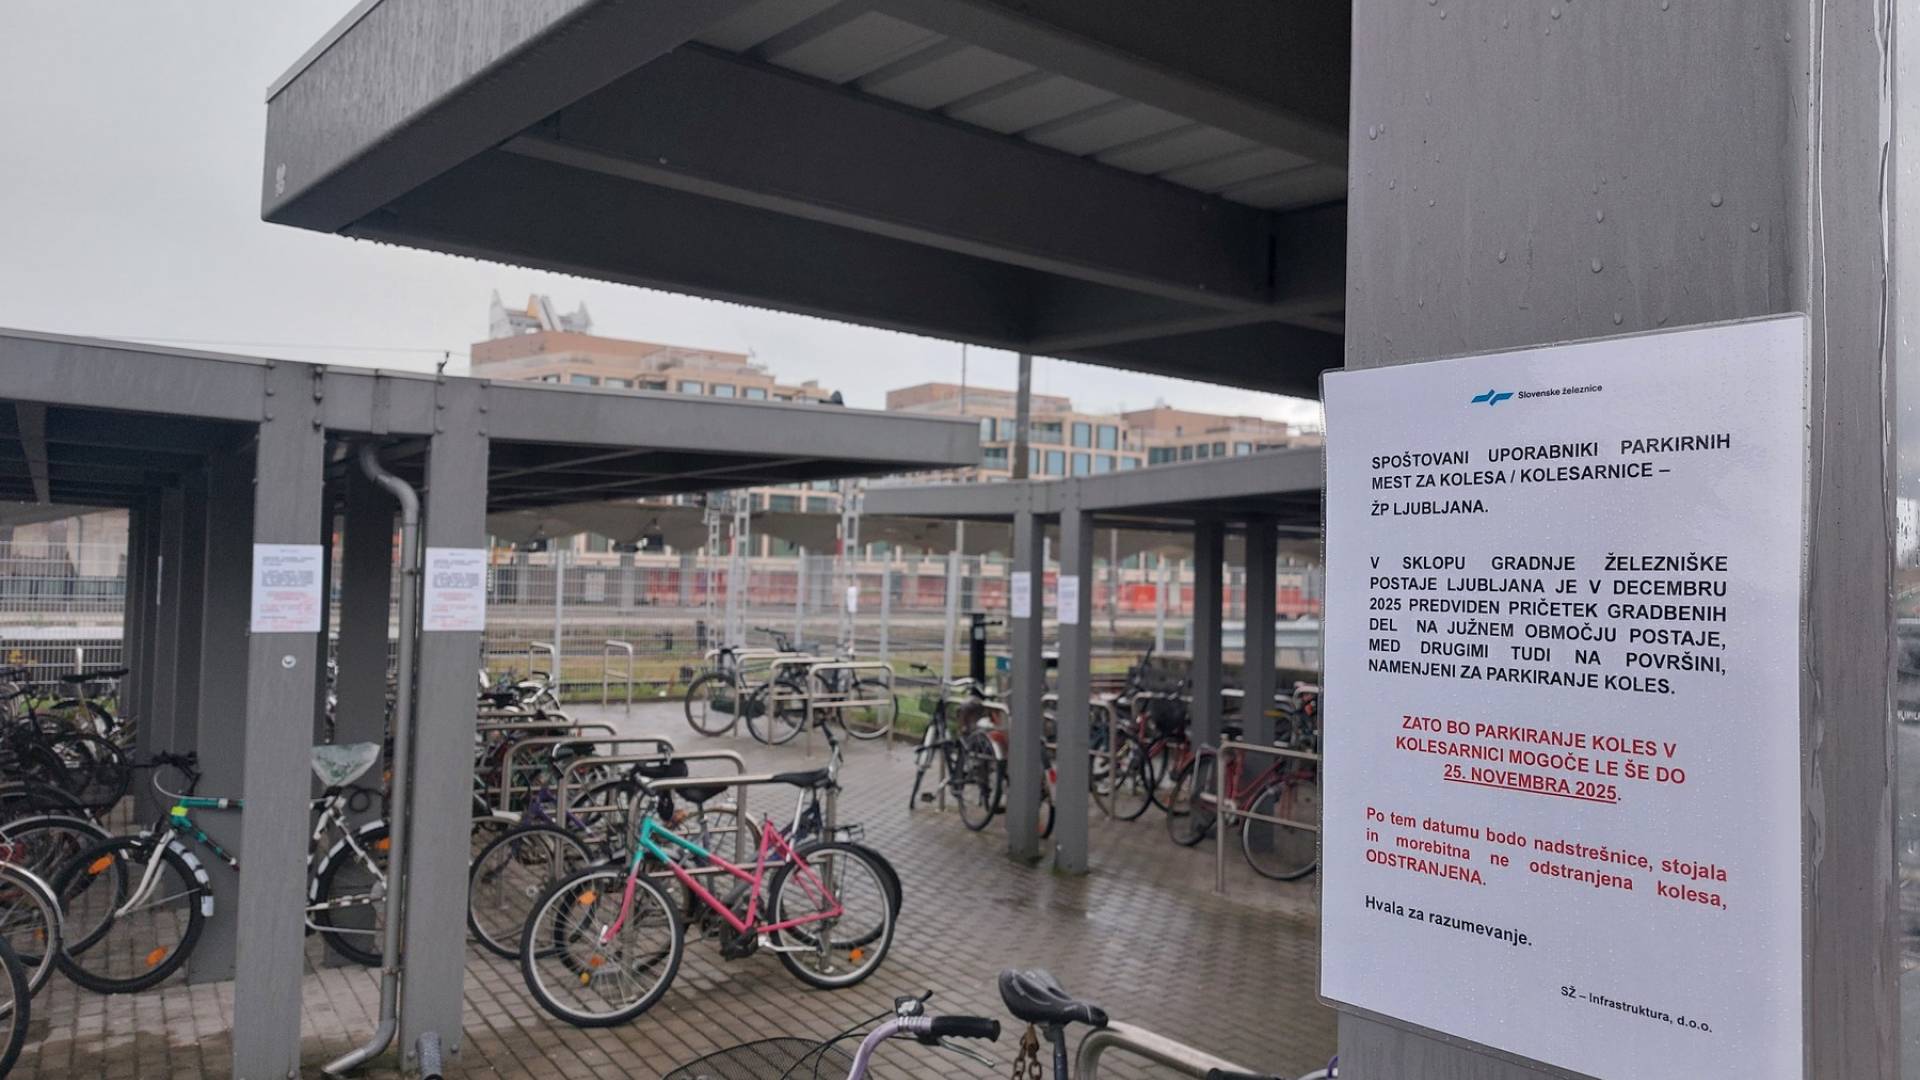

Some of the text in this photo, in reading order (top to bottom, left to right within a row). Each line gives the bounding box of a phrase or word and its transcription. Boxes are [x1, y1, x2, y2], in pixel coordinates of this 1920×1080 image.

[1517, 383, 1603, 400] Slovenske železnice
[1371, 432, 1731, 470] SPOŠTOVANI UPORABNIKI PARKIRNIH
[1371, 474, 1413, 491] MEST
[1415, 473, 1437, 488] ZA
[1439, 469, 1507, 487] KOLESA
[1520, 461, 1654, 484] KOLESARNICE
[1370, 499, 1489, 517] ŽP LJUBLJANA.
[1369, 551, 1728, 572] V SKLOPU GRADNJE ŽELEZNIŠKE
[1369, 576, 1727, 598] POSTAJE LJUBLJANA JE V DECEMBRU
[1369, 596, 1727, 623] 2025 PREDVIDEN PRIČETEK GRADBENIH
[1369, 617, 1726, 651] DEL NA JUŽNEM OBMOČJU POSTAJE,
[1368, 637, 1726, 677] MED DRUGIMI TUDI NA POVRŠINI,
[1368, 658, 1676, 695] NAMENJENI ZA PARKIRANJE KOLES.
[1402, 715, 1677, 759] ZATO BO PARKIRANJE KOLES V
[1395, 735, 1686, 785] KOLESARNICI MOGOČE LE ŠE DO
[1443, 763, 1622, 802] 25. NOVEMBRA 2025.
[1366, 806, 1728, 883] Po tem datumu bodo nadstrešnice, stojala
[1365, 849, 1487, 887] ODSTRANJENA.
[1366, 827, 1727, 911] in morebitna ne odstranjena kolesa,
[1365, 894, 1533, 947] Hvala za razumevanje.
[1560, 985, 1577, 999] SŽ
[1589, 992, 1673, 1025] Infrastruktura,
[1676, 1015, 1713, 1033] d.o.o.
